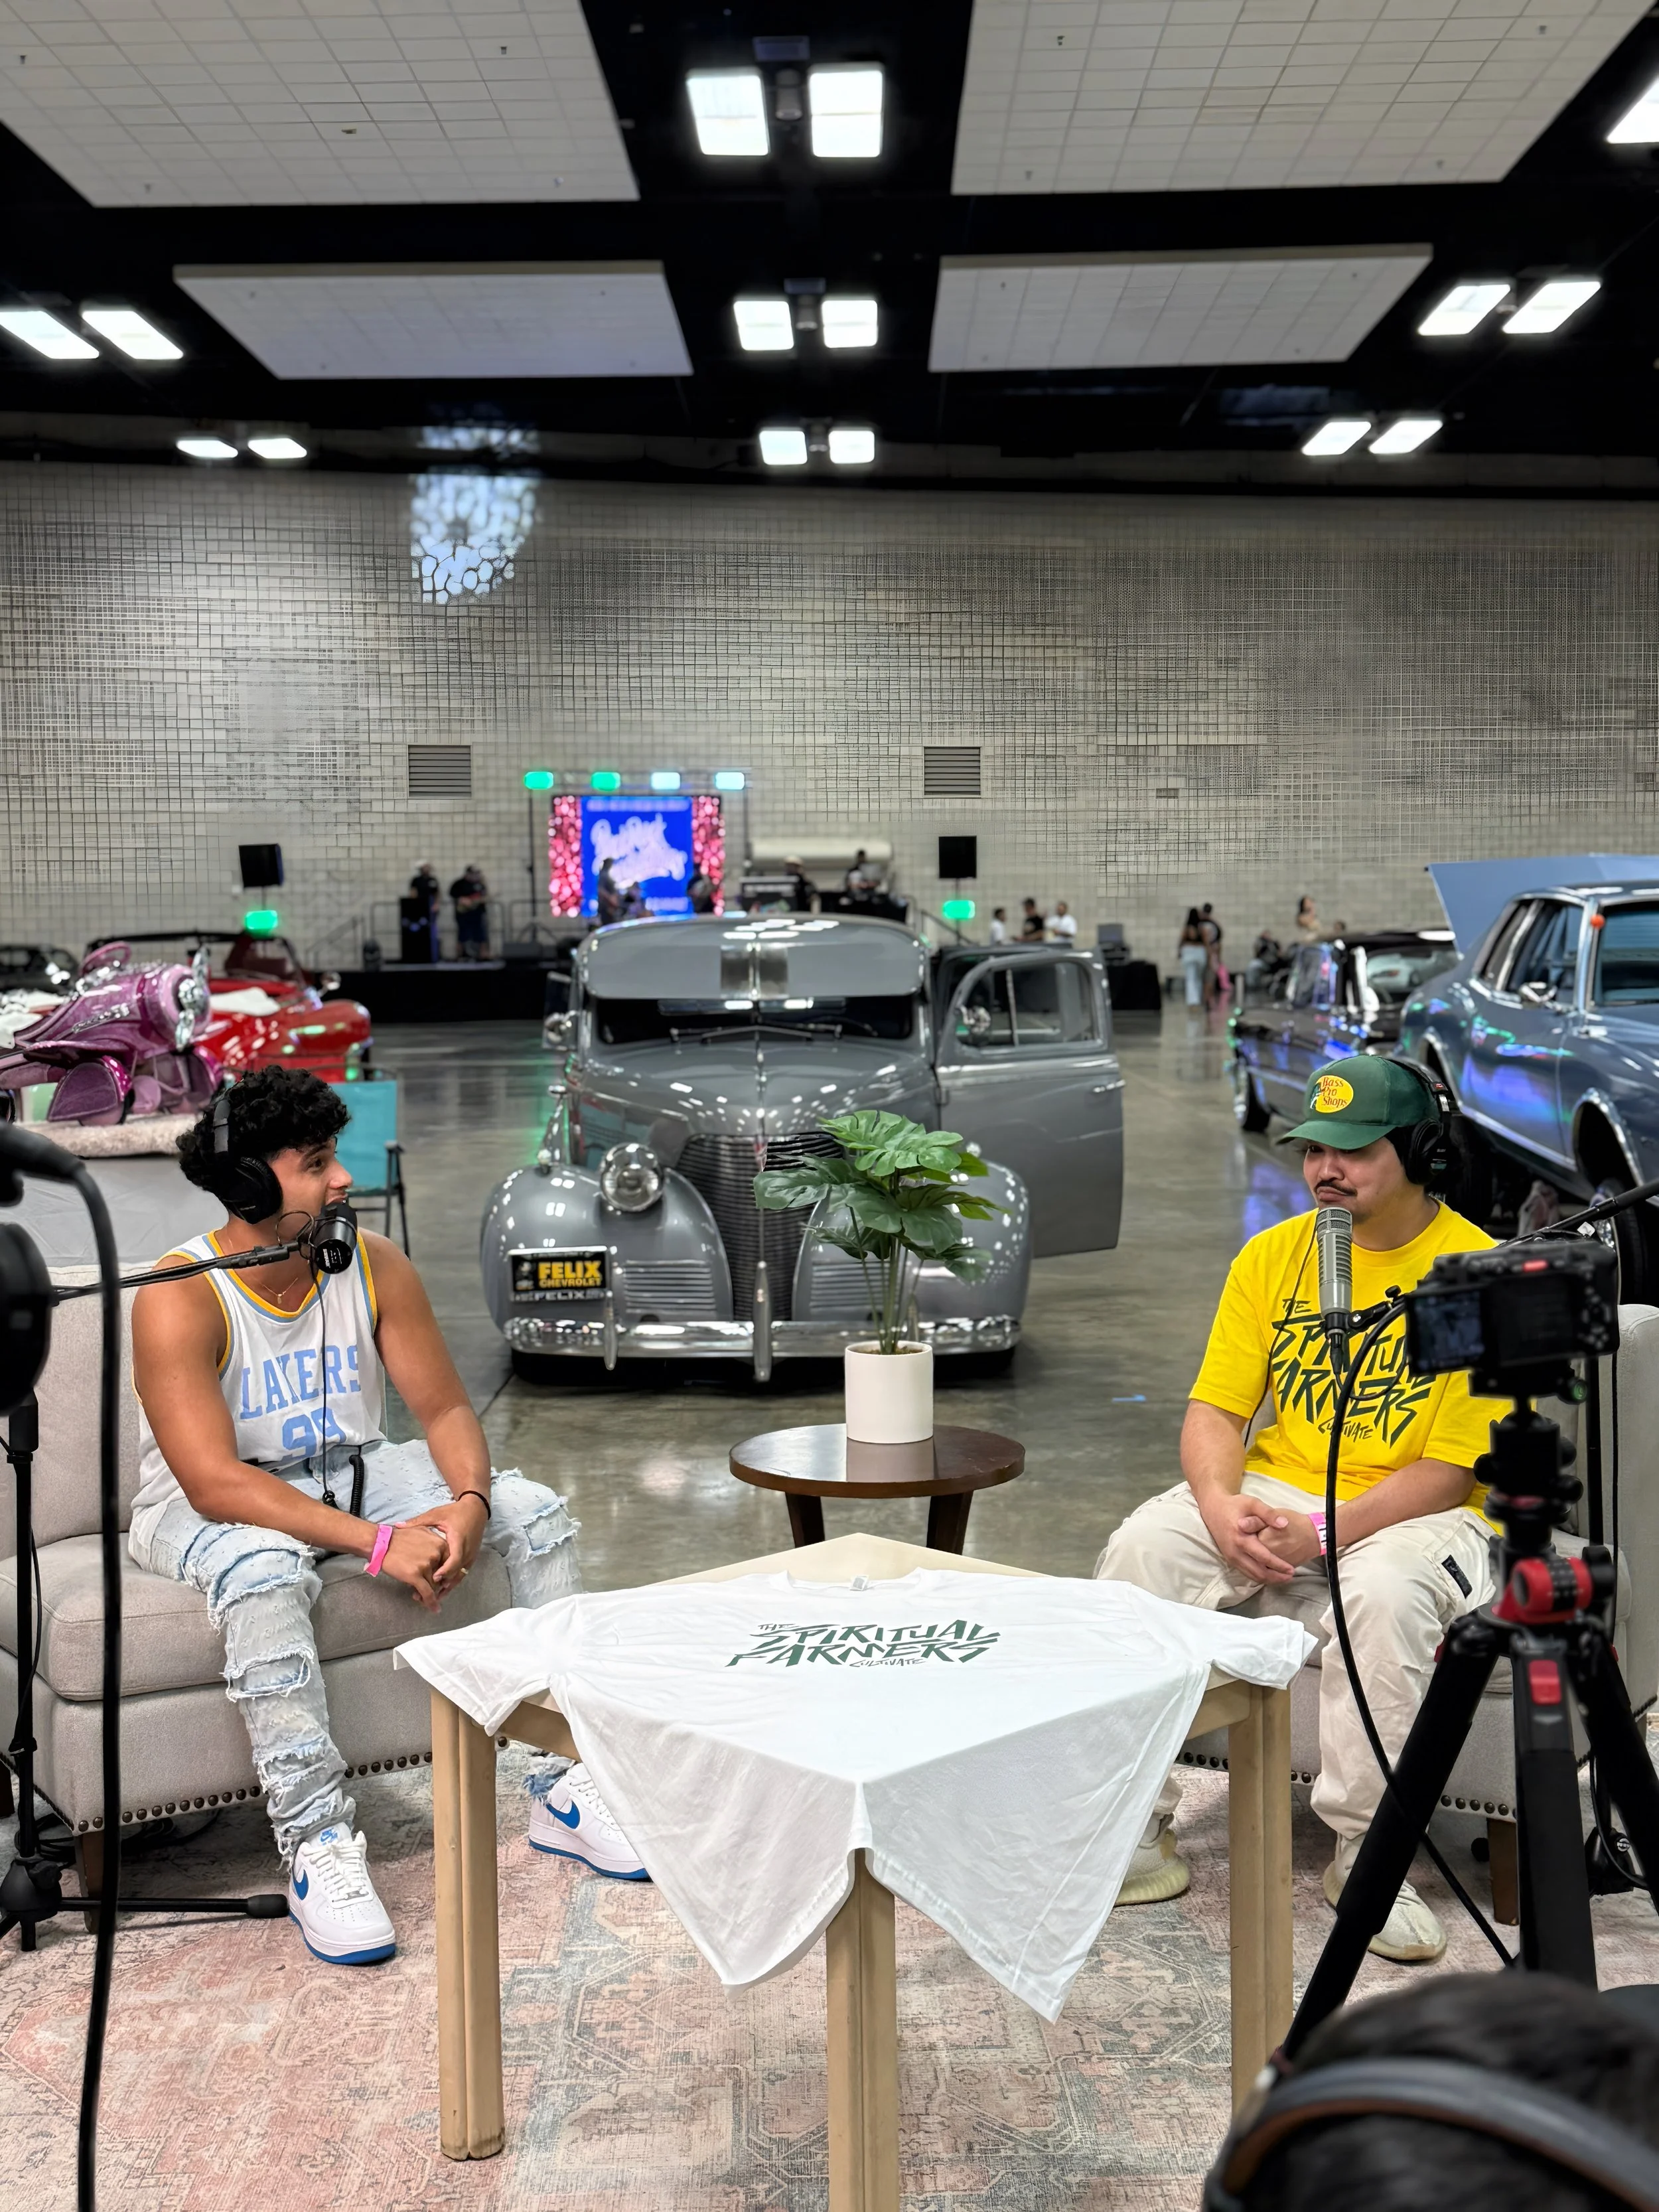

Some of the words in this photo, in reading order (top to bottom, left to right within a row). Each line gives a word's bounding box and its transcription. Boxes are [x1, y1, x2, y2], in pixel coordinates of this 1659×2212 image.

[1323, 1077, 1344, 1086] Bass
[1323, 1087, 1337, 1096] Pro
[1323, 1096, 1348, 1108] Shops
[538, 1260, 602, 1279] FELIX
[539, 1278, 603, 1288] CHEVROLET
[749, 1619, 1001, 1651] SPIRITUAL
[725, 1637, 998, 1667] FARMERS
[849, 1658, 926, 1668] CULTIVATE
